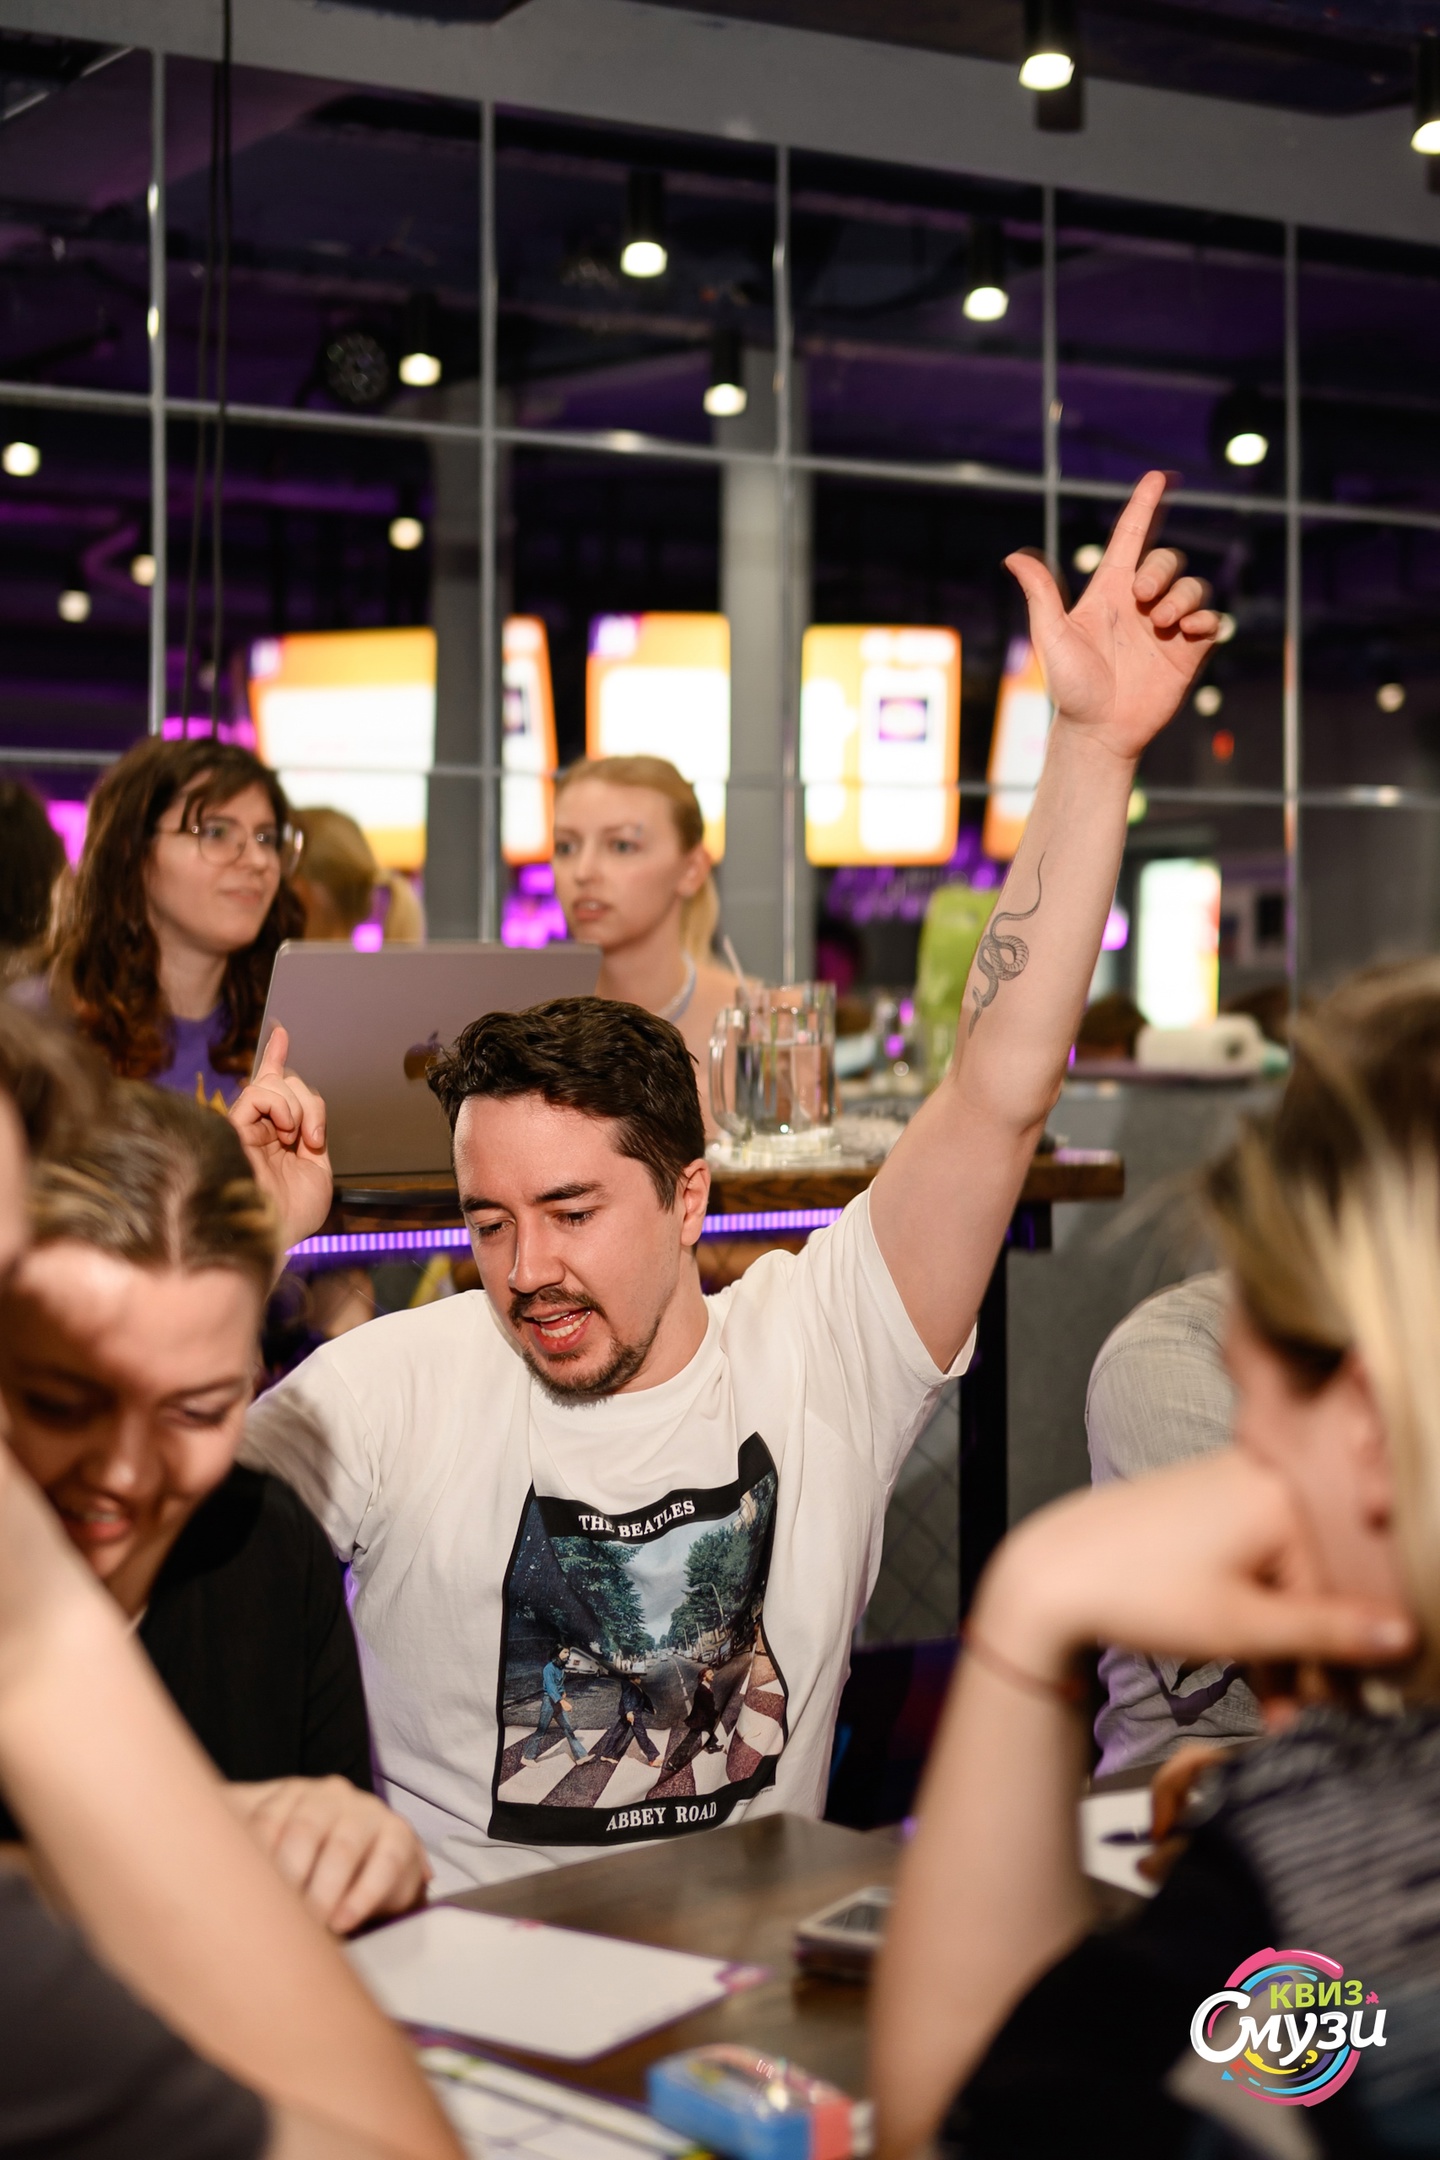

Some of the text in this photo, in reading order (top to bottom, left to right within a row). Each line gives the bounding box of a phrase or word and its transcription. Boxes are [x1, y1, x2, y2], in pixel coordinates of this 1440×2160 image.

[578, 1499, 696, 1538] THE BEATLES
[606, 1801, 717, 1832] ABBEY ROAD
